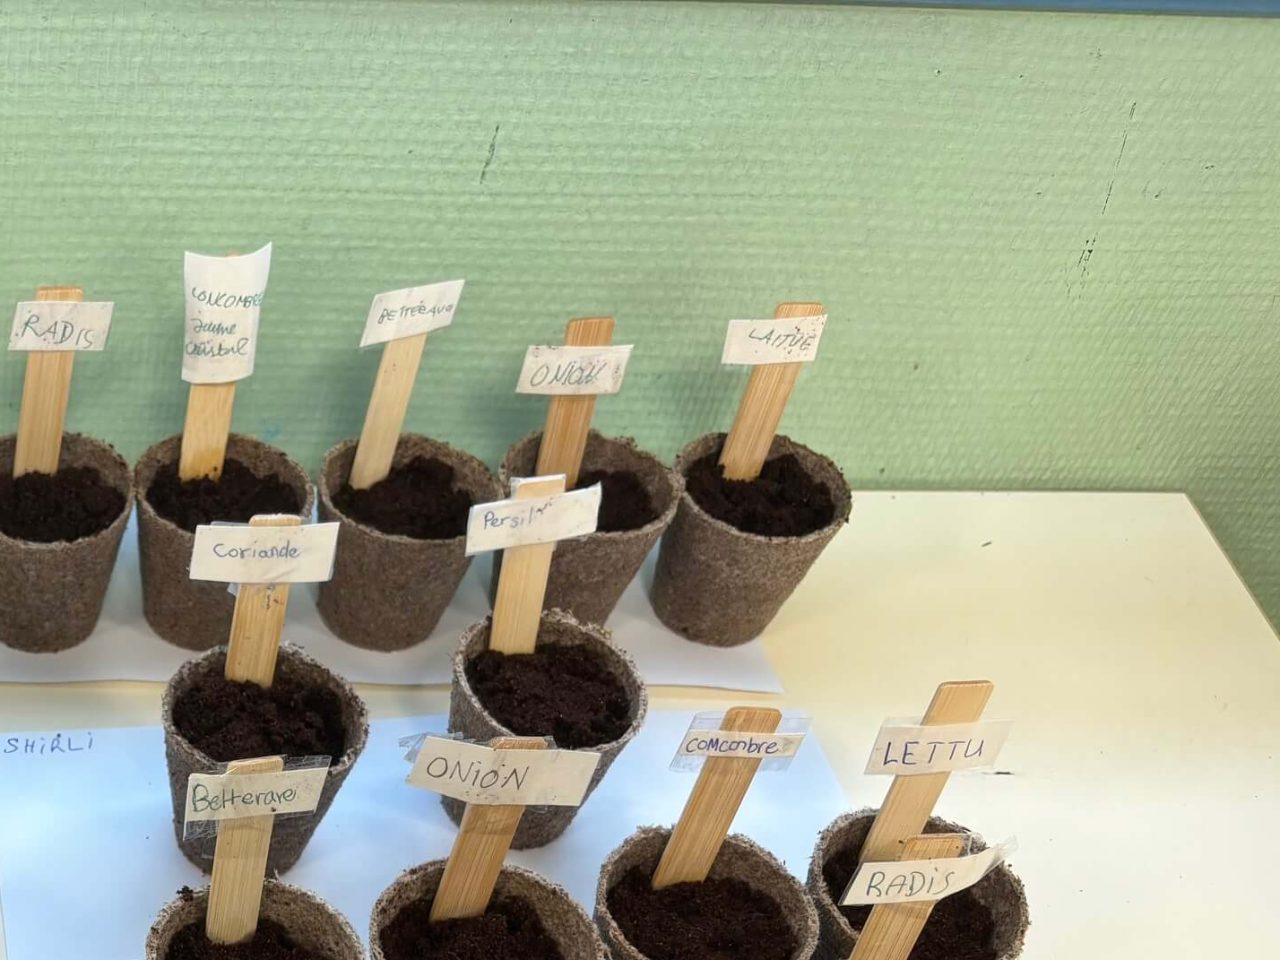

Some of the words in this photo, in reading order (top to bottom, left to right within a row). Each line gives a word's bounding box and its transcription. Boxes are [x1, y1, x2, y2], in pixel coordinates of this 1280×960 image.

[20, 313, 95, 349] RADIS
[212, 540, 301, 559] Coriande
[883, 739, 985, 766] LETTU
